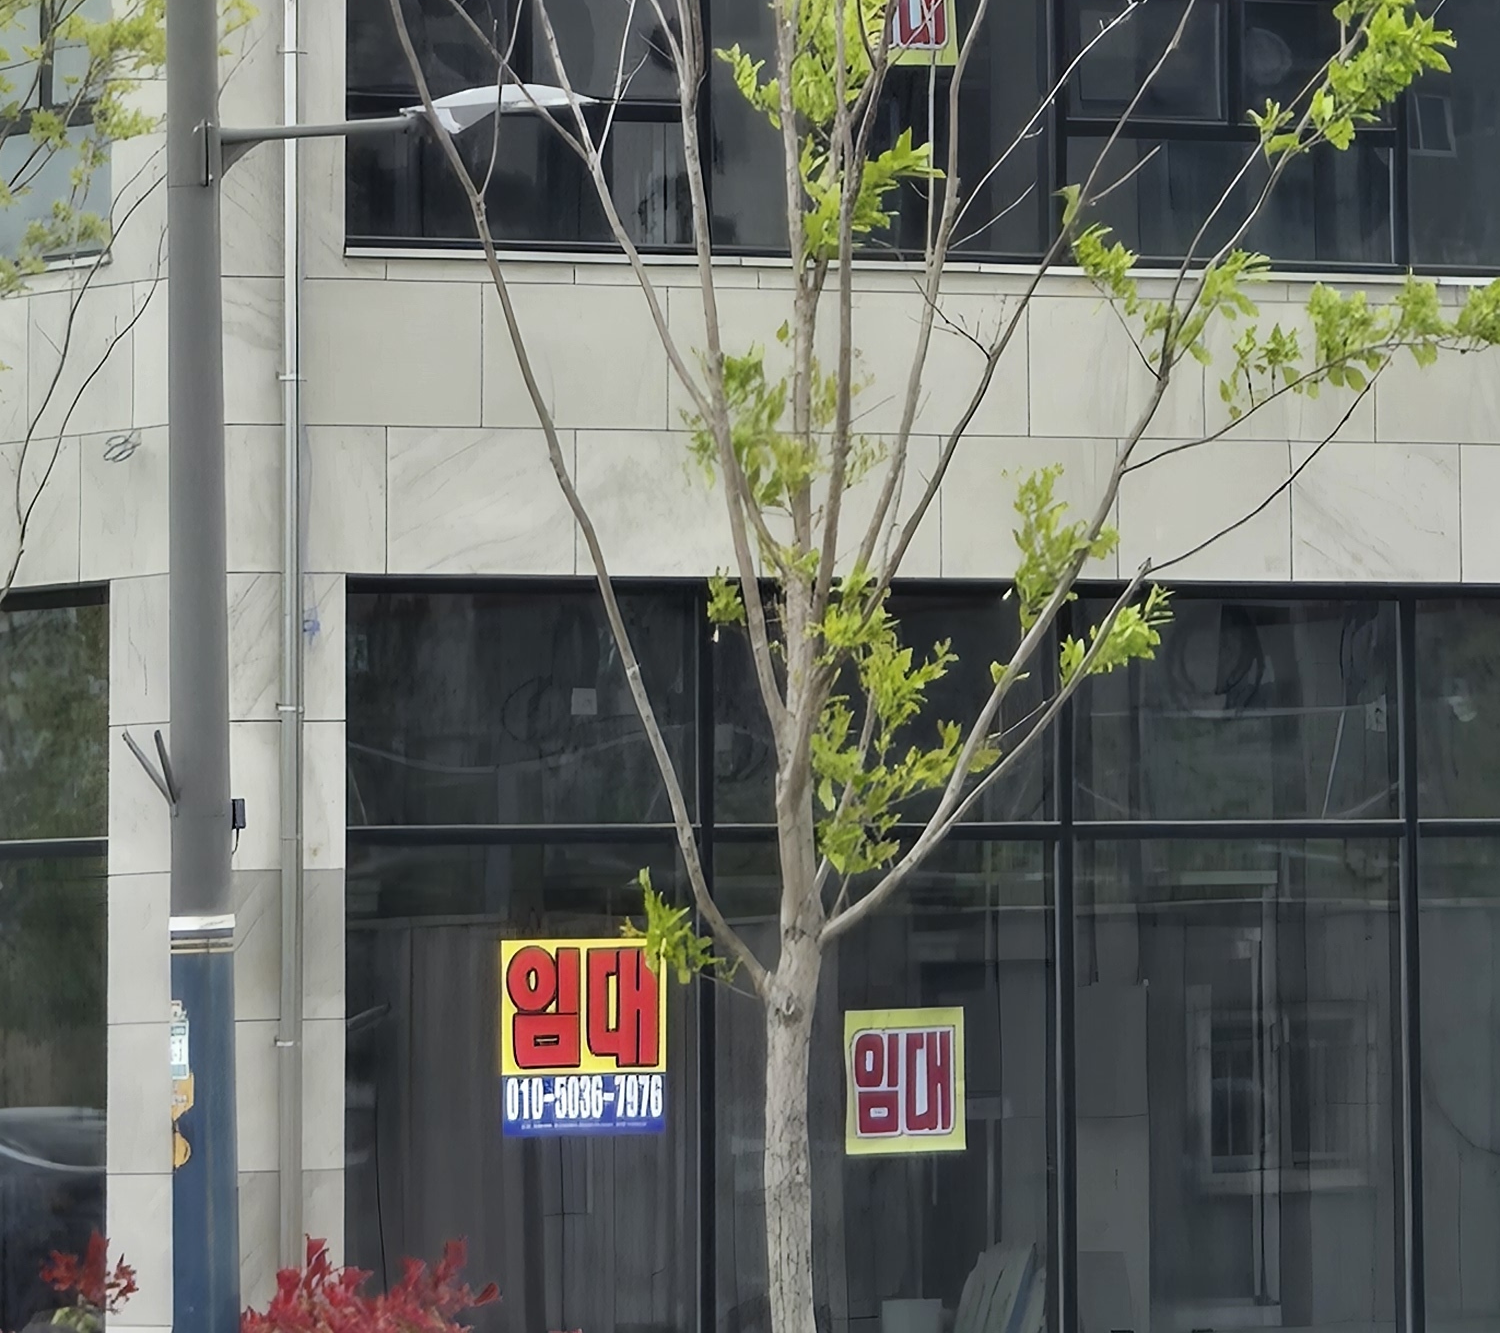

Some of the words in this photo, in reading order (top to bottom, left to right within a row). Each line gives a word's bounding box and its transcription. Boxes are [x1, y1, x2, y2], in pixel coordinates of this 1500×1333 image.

[506, 945, 660, 1069] 임대
[506, 1074, 663, 1121] 010-5036-7976
[850, 1027, 955, 1138] 임대
